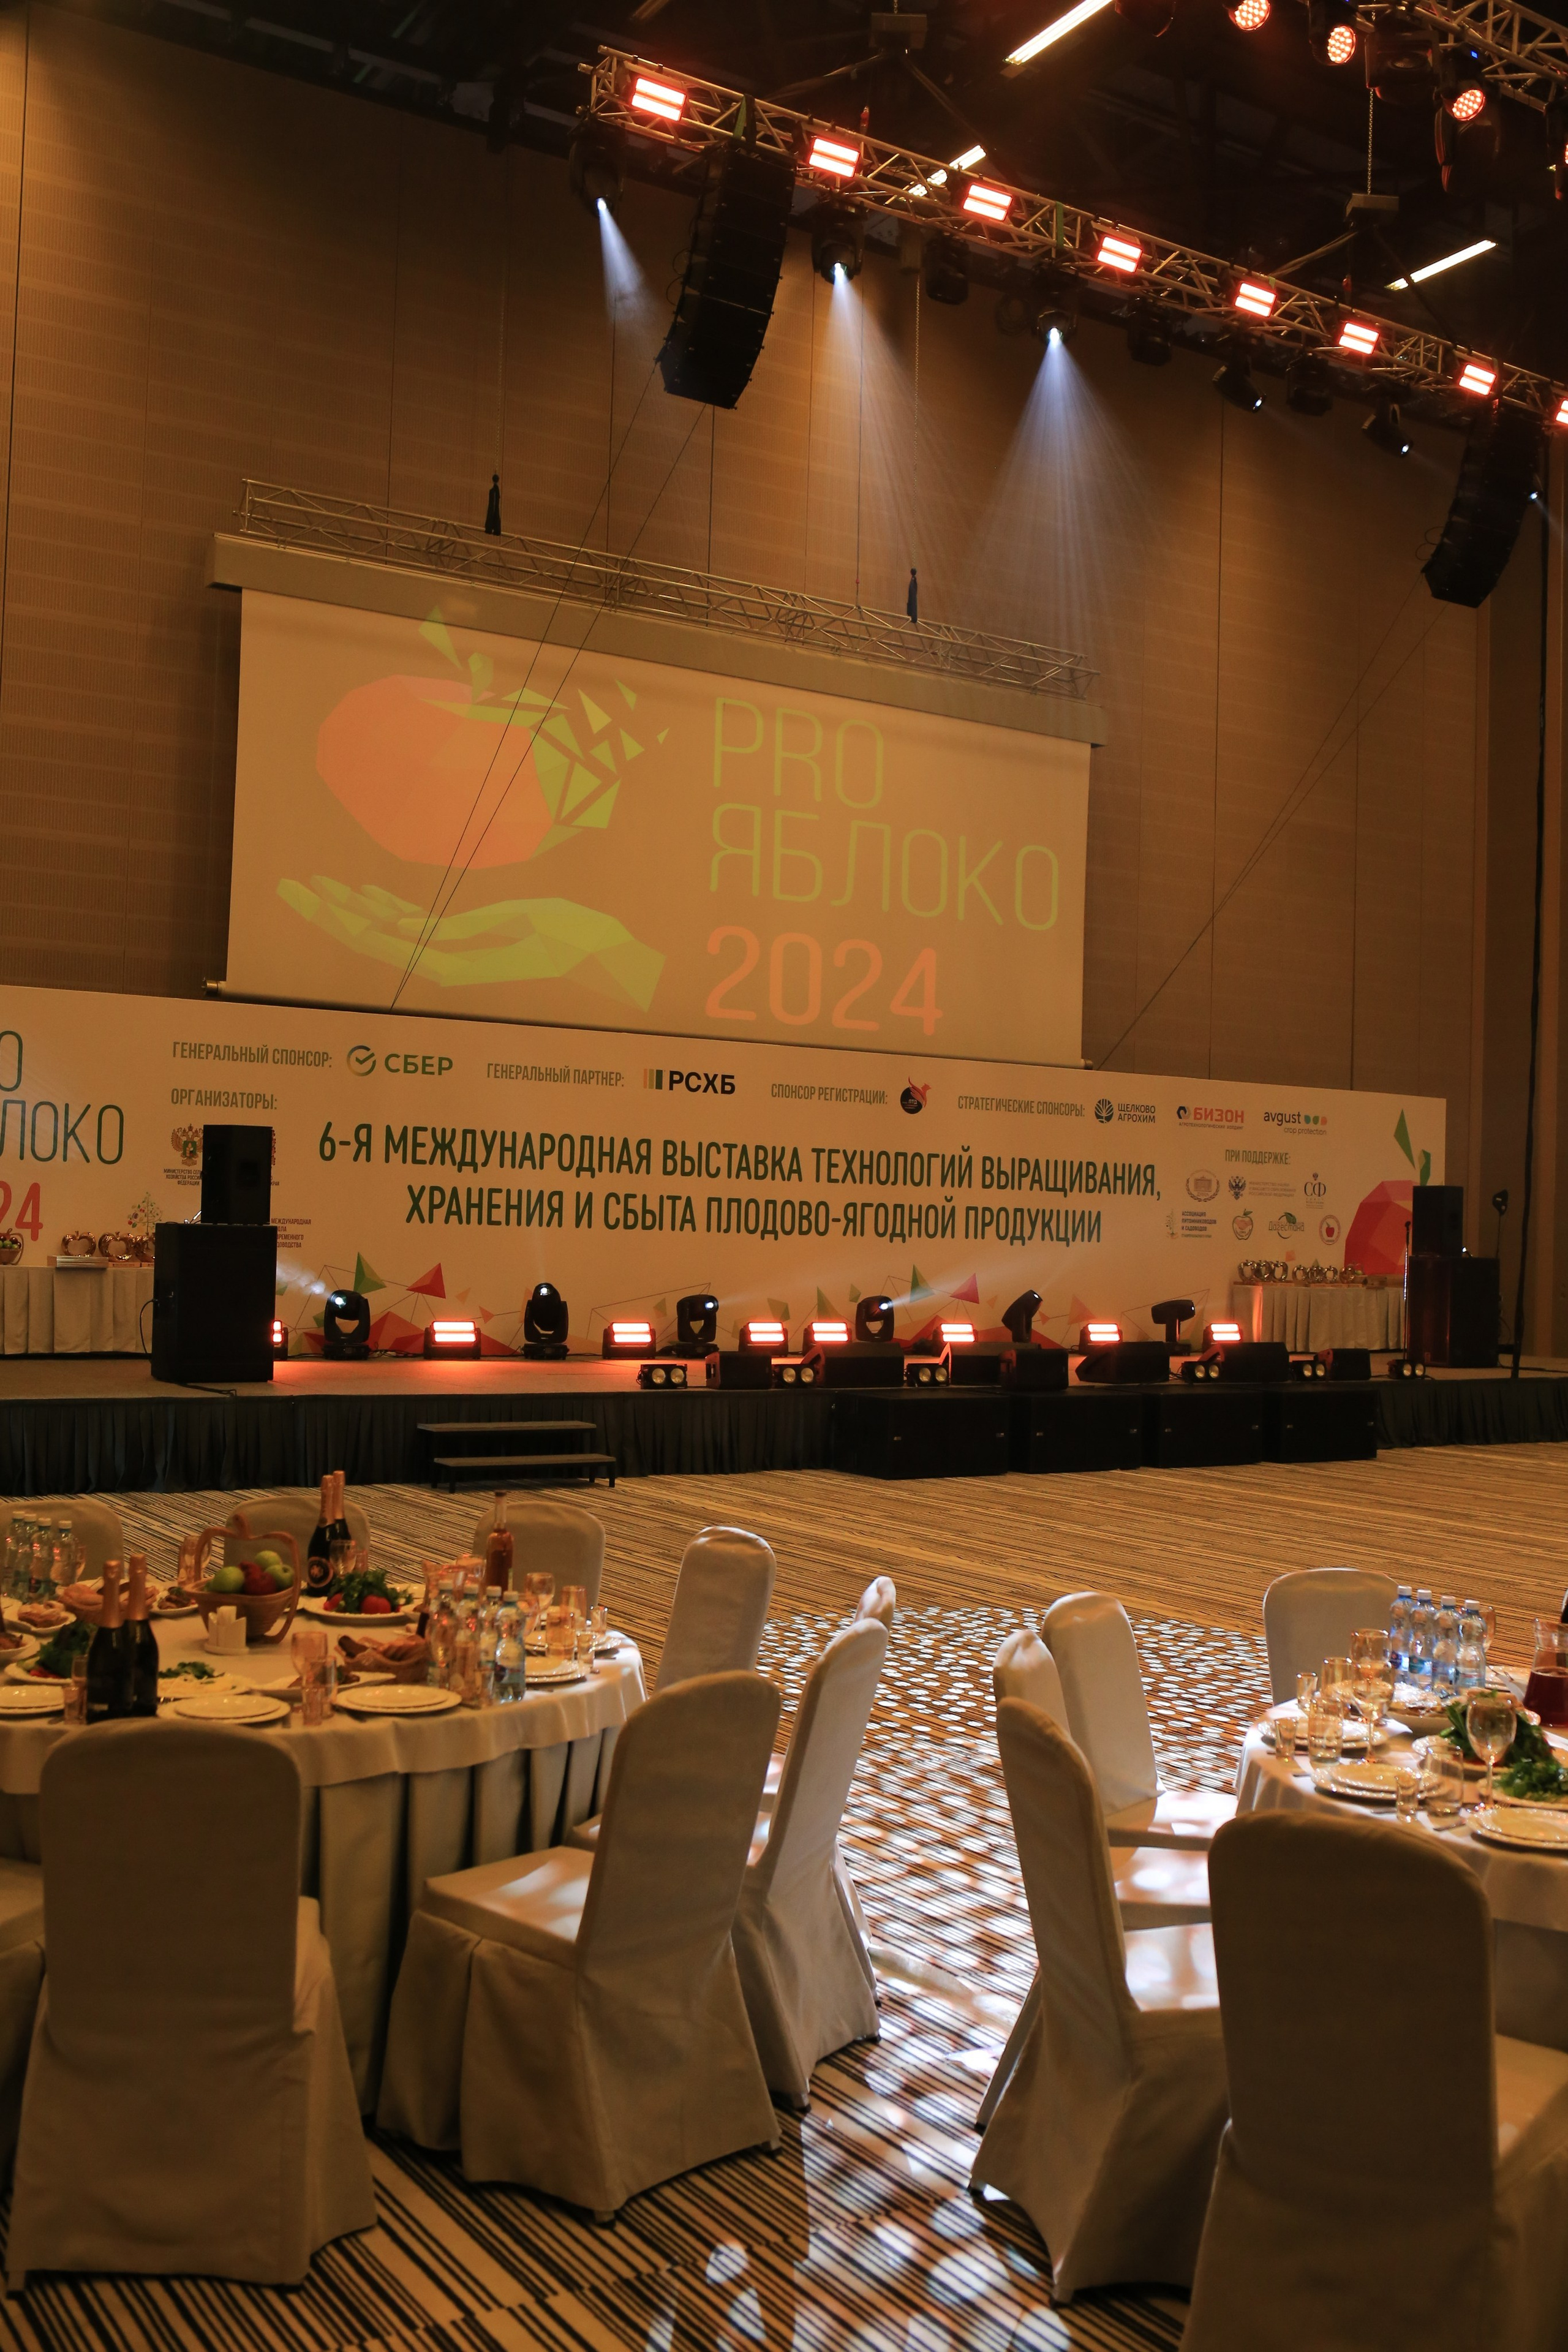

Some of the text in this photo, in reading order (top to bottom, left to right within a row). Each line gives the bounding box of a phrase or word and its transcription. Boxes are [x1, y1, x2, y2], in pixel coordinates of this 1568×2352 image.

[714, 697, 883, 809] PRO
[710, 803, 1058, 931] ЯБЛОКО
[705, 925, 943, 1036] 2024
[172, 1041, 333, 1068] ГЕНЕРАЛЬНЫЙ СПОНСОР:
[384, 1053, 453, 1076] СБЕР
[487, 1063, 624, 1087] ГЕНЕРАЛЬНЫЙ ПАРТНЕР:
[669, 1070, 736, 1095] РСХБ
[171, 1088, 277, 1110] ОРГАНИЗАТОРЫ:
[771, 1083, 888, 1105] СПОНСОР РЕГИСТРАЦИИ:
[958, 1095, 1085, 1117] СТРАТЕГИЧЕСКИЕ СПОНСОРЫ:
[1118, 1103, 1156, 1114] ЩЕЛКОВО
[1193, 1107, 1245, 1123] БИЗОН
[1118, 1113, 1156, 1123] АГРОХИМ
[1264, 1111, 1302, 1126] avgust
[319, 1121, 1161, 1201] 6-Я МЕЖДУНАРОДНАЯ ВЫСТАВКА ТЕХНОЛОГИЙ ВЫРАЩИВАНИЯ,
[1225, 1149, 1291, 1165] ПРИ ПОДДЕРЖКЕ:
[405, 1184, 1101, 1248] ХРАНЕНИЯ И СБЫТА ПЛОДОВО-ЯГОДНОЙ ПРОДУКЦИИ
